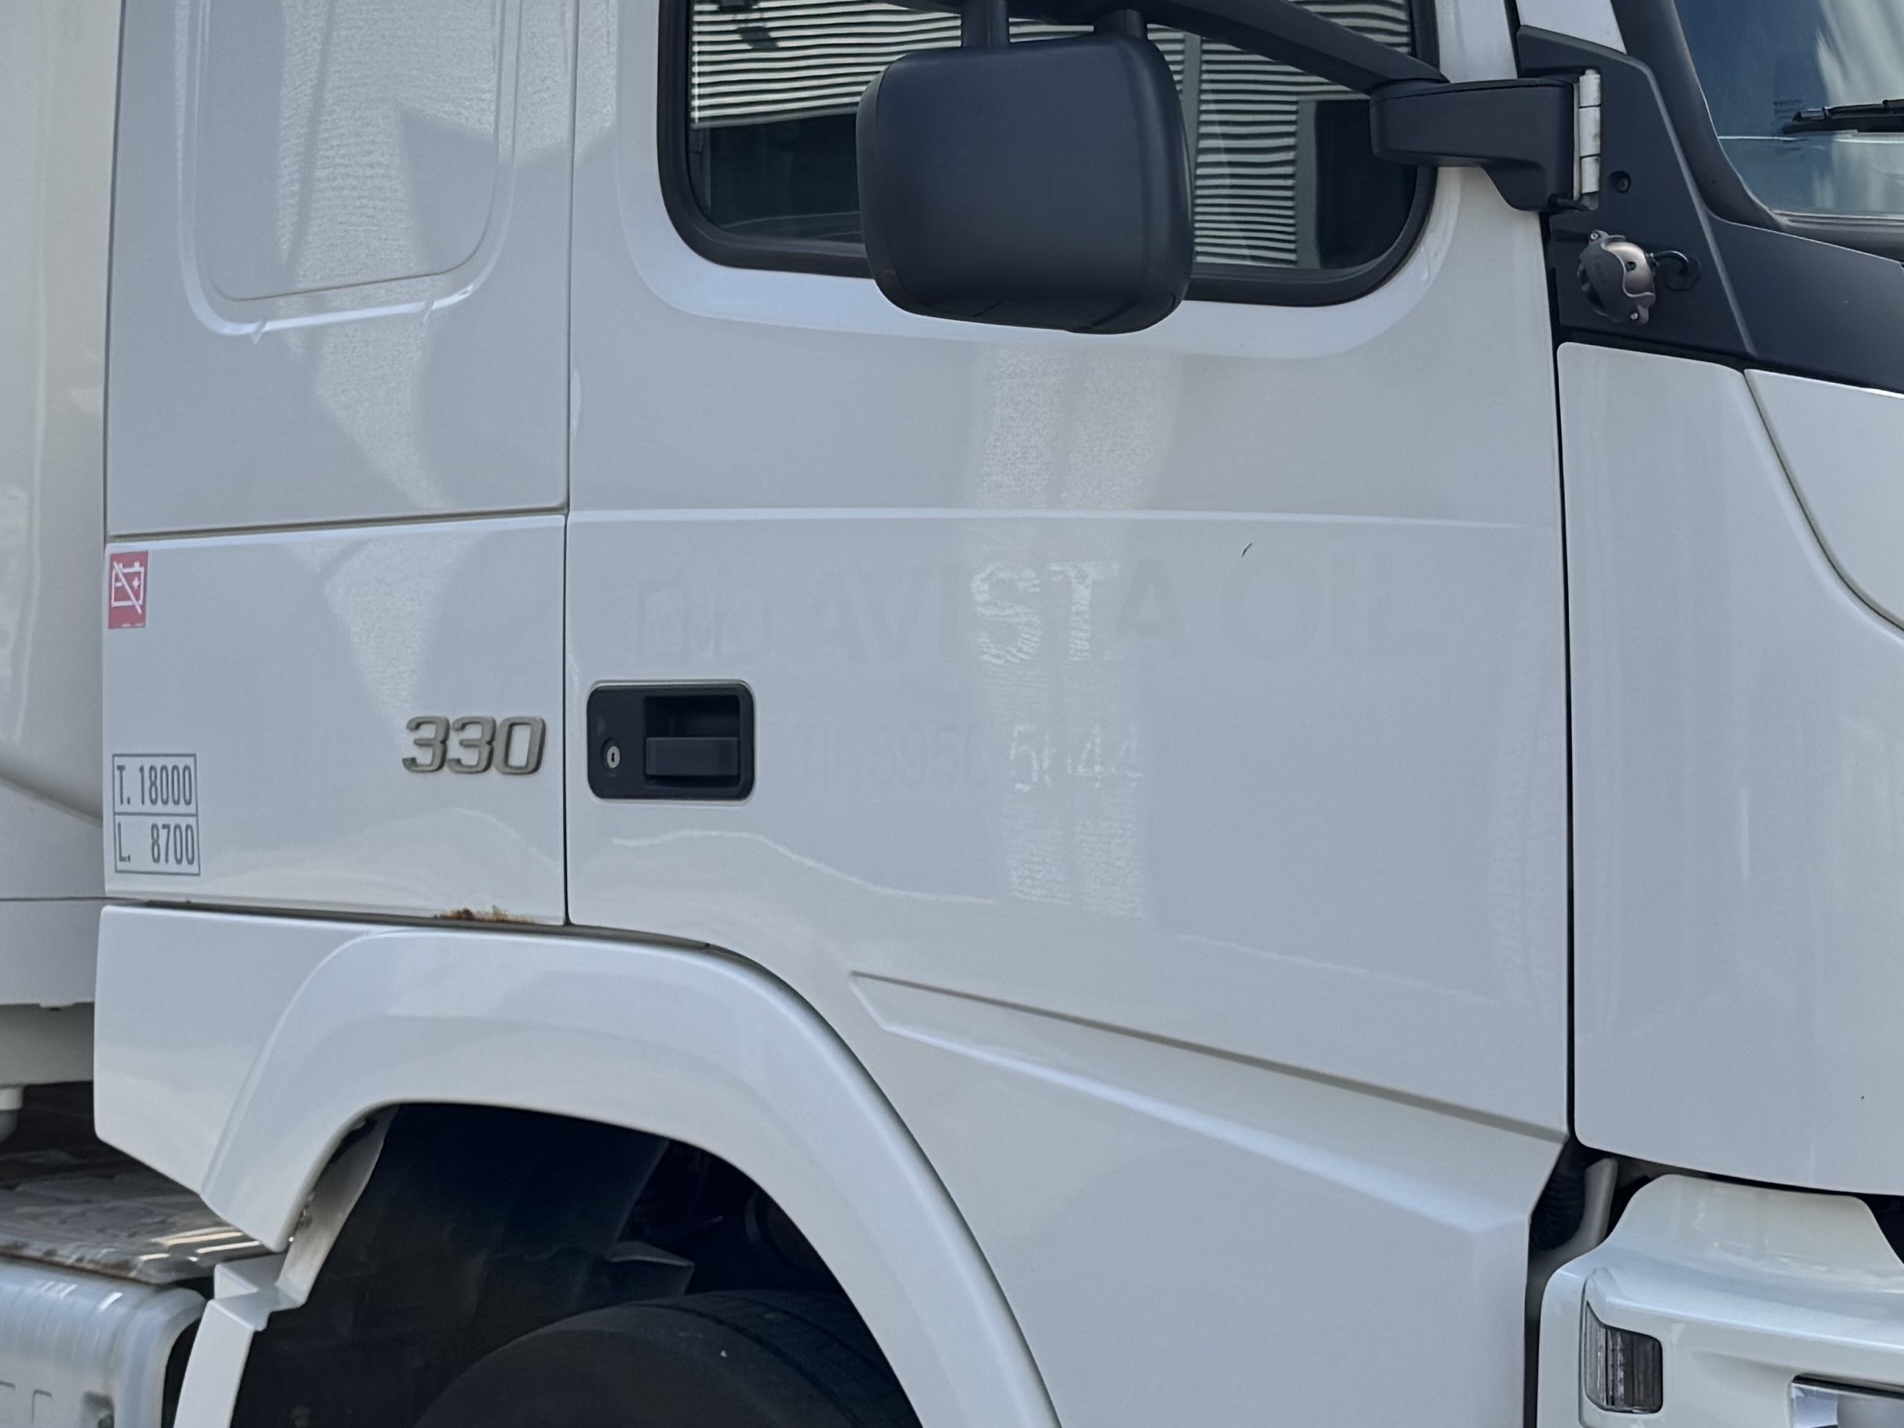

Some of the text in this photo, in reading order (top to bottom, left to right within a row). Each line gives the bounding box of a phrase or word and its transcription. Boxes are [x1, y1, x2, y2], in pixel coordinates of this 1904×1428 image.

[401, 715, 546, 775] 330
[116, 764, 194, 807] T. 18000
[117, 822, 196, 865] L. 8700
